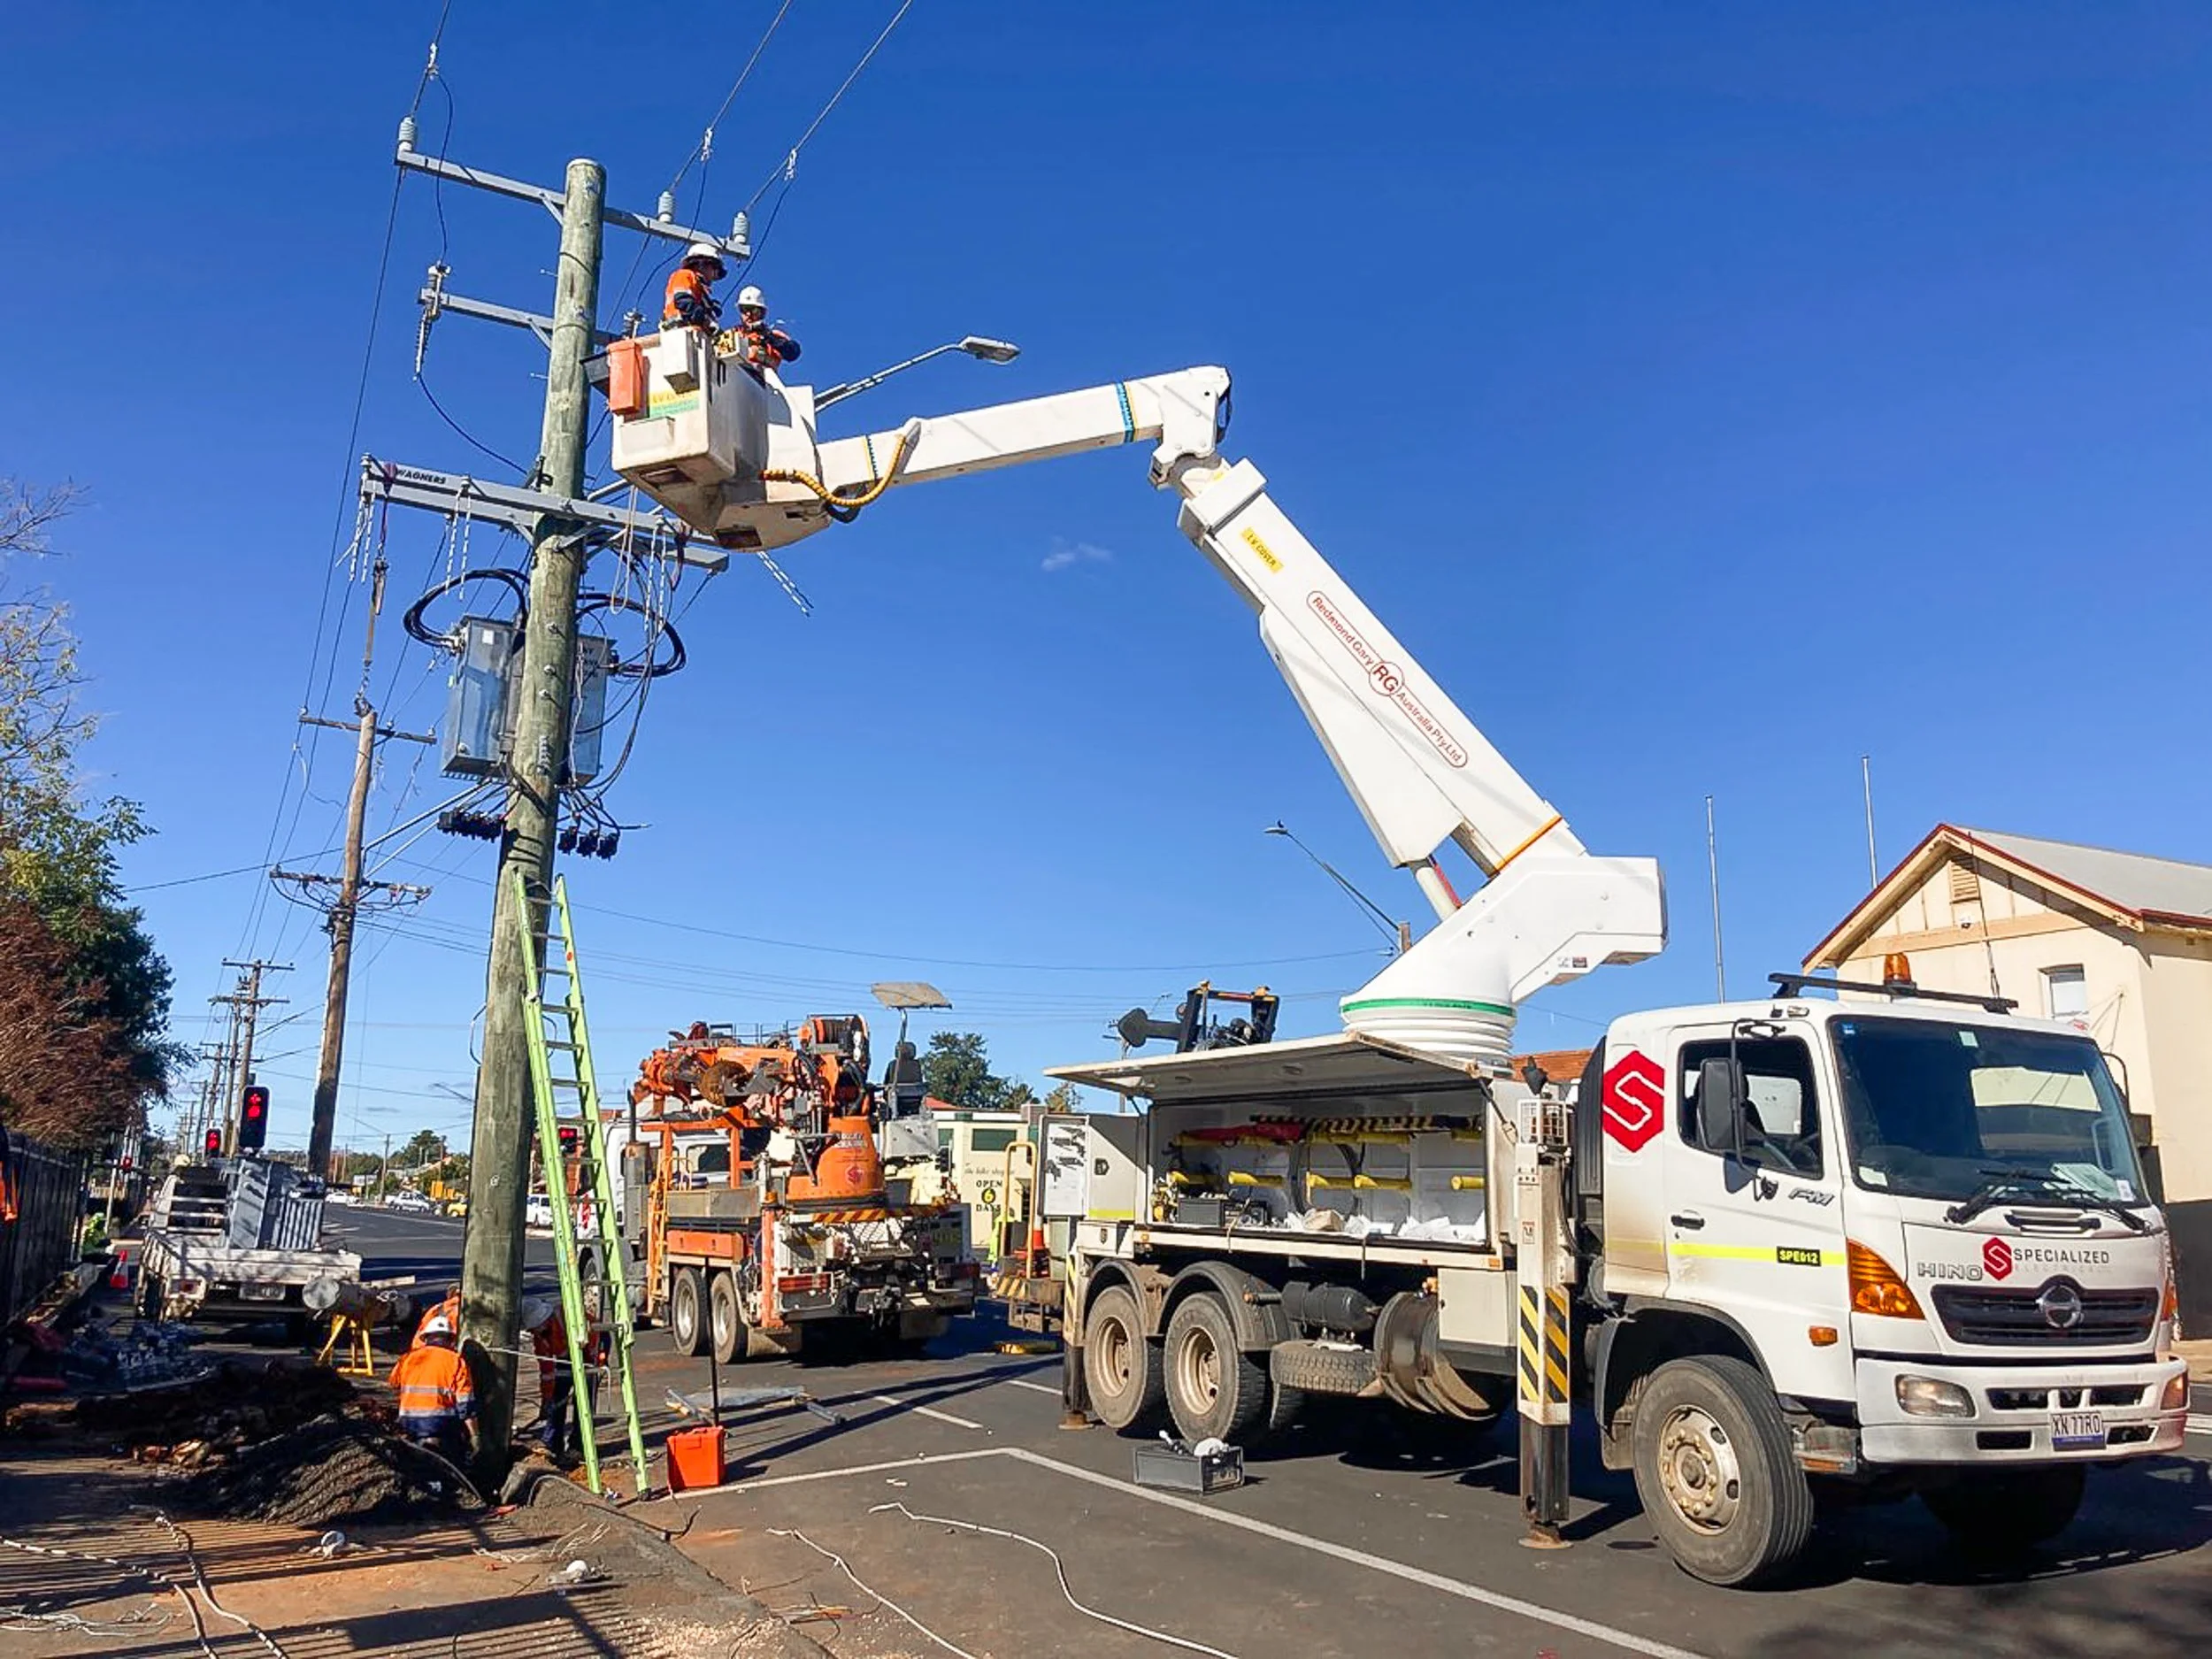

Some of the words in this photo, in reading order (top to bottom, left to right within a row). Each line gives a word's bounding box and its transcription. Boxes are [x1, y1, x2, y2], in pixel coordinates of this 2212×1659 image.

[1312, 596, 1356, 643] Redmond
[1352, 641, 1374, 665] Gary
[1372, 664, 1399, 692] RG
[1396, 692, 1433, 732] Australia
[983, 1188, 994, 1203] 6
[1778, 1249, 1819, 1264] SPE012
[2013, 1248, 2109, 1264] SPECIALIZED
[1917, 1262, 1983, 1280] HINO
